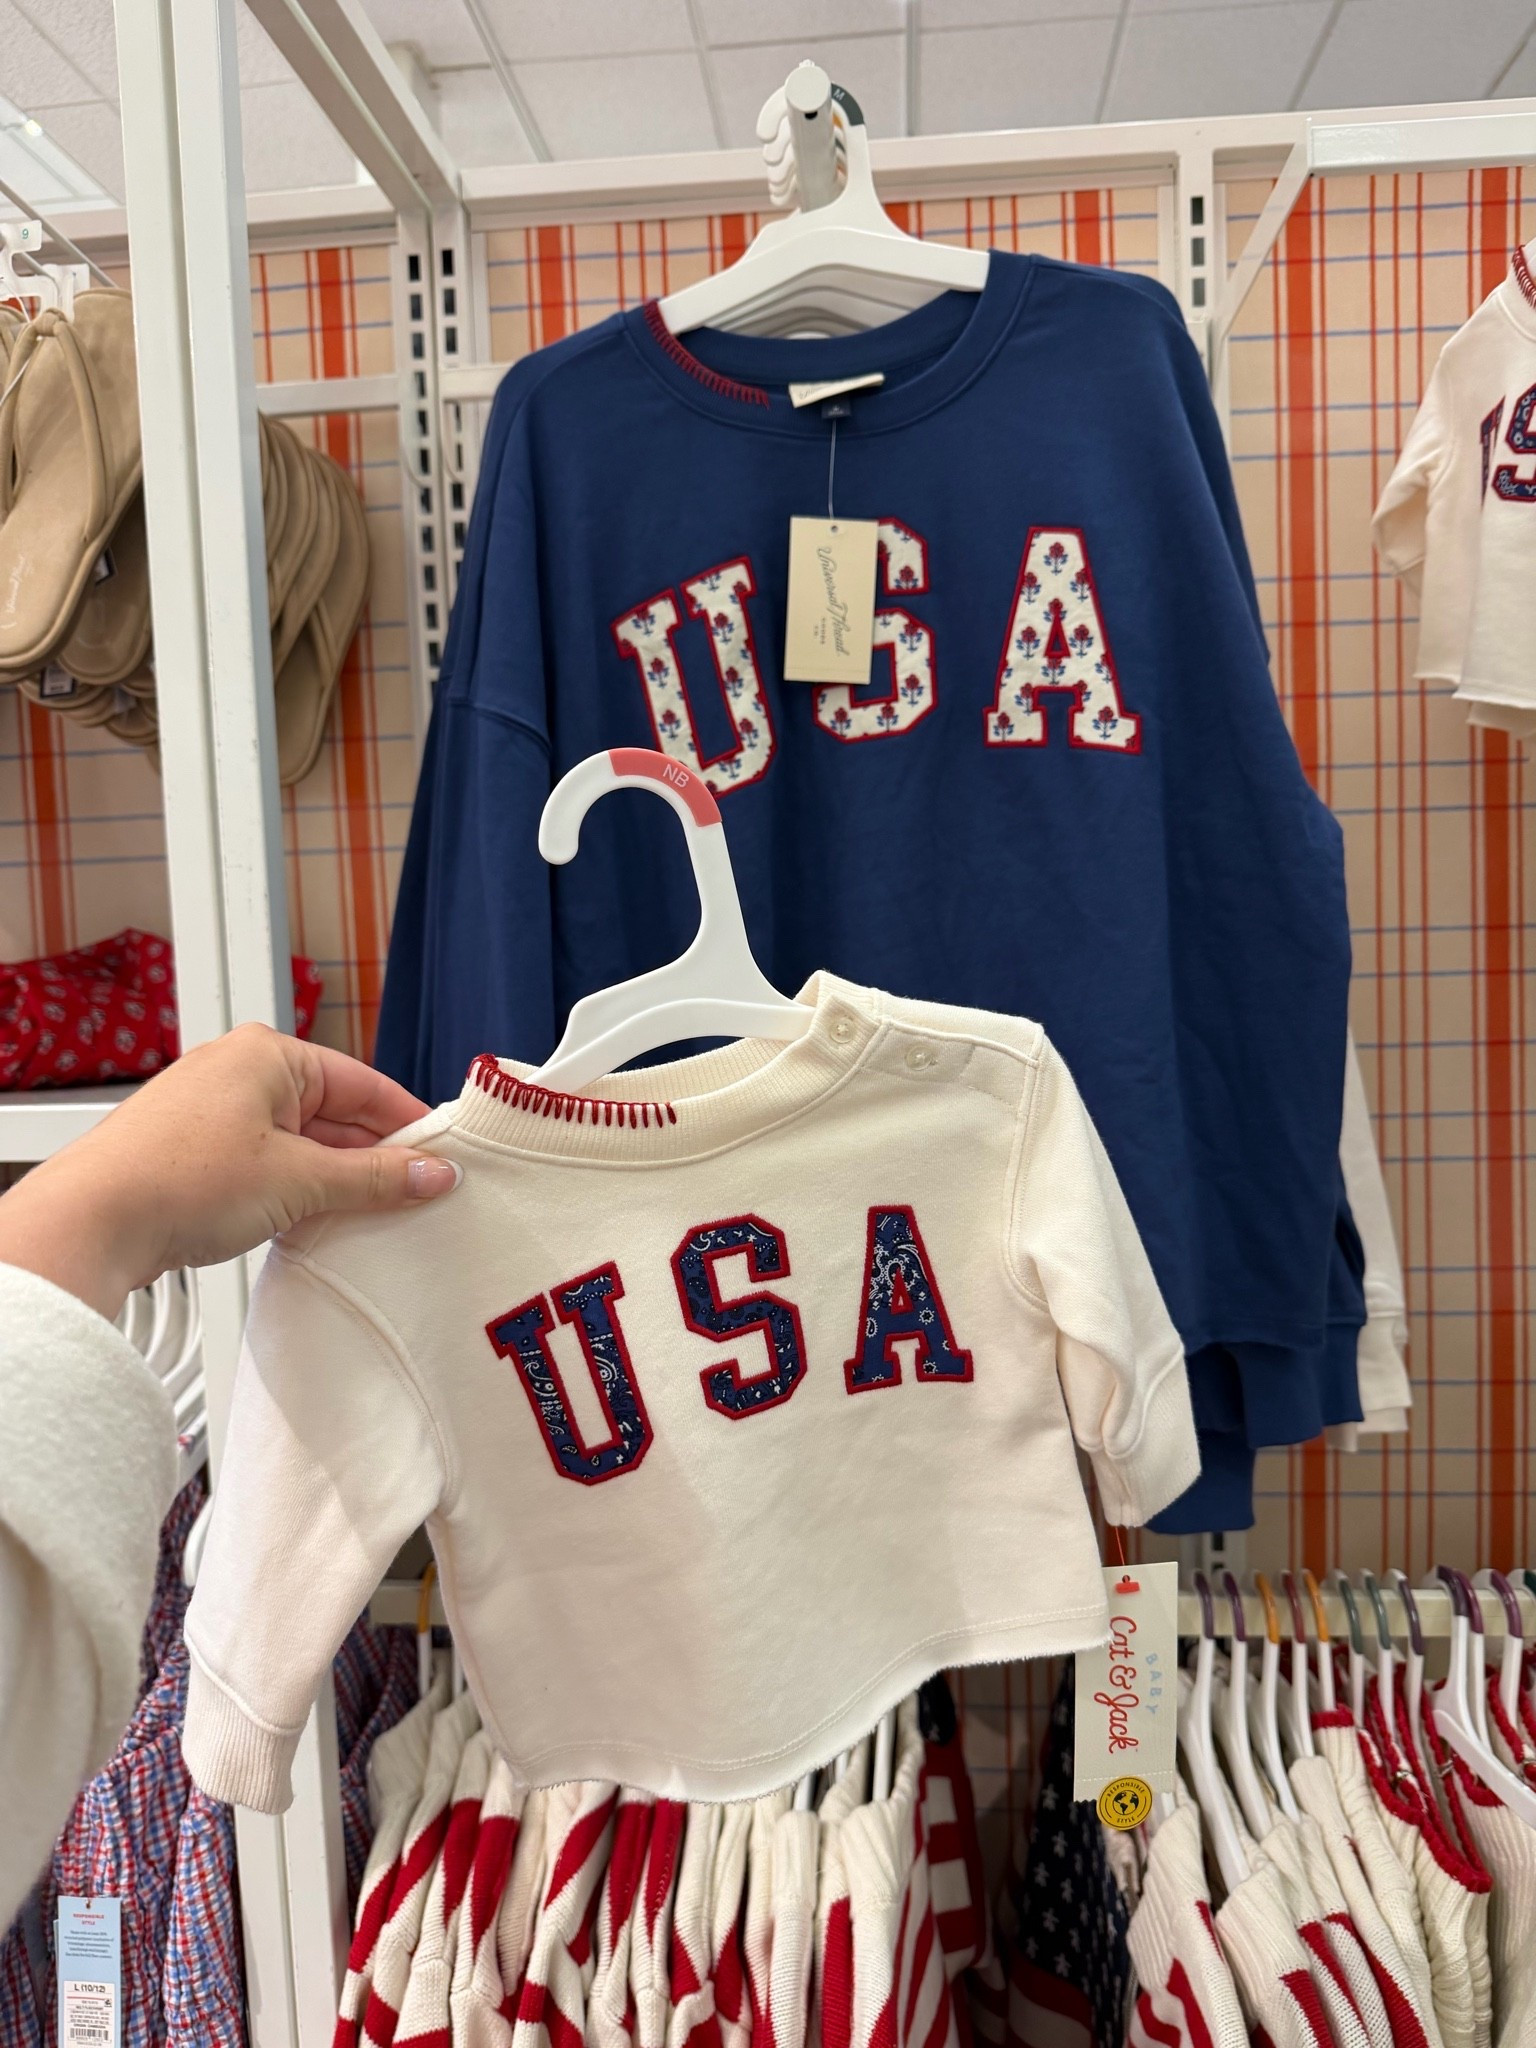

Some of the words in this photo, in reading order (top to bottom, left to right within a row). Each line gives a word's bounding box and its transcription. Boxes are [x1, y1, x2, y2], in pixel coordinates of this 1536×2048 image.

[834, 88, 845, 100] M
[22, 228, 29, 240] 9
[816, 546, 844, 611] Universal
[826, 602, 851, 656] Thread
[610, 516, 1142, 798] USA
[662, 763, 690, 788] NB
[485, 1205, 974, 1486] USA
[1109, 1615, 1138, 1661] Cat
[1109, 1664, 1137, 1690] &
[1145, 1653, 1163, 1715] BABY
[1093, 1692, 1140, 1755] Jack
[1107, 1781, 1145, 1797] RESPONSIBLE
[74, 1983, 80, 1991] L
[81, 1984, 106, 1993] (10/12)
